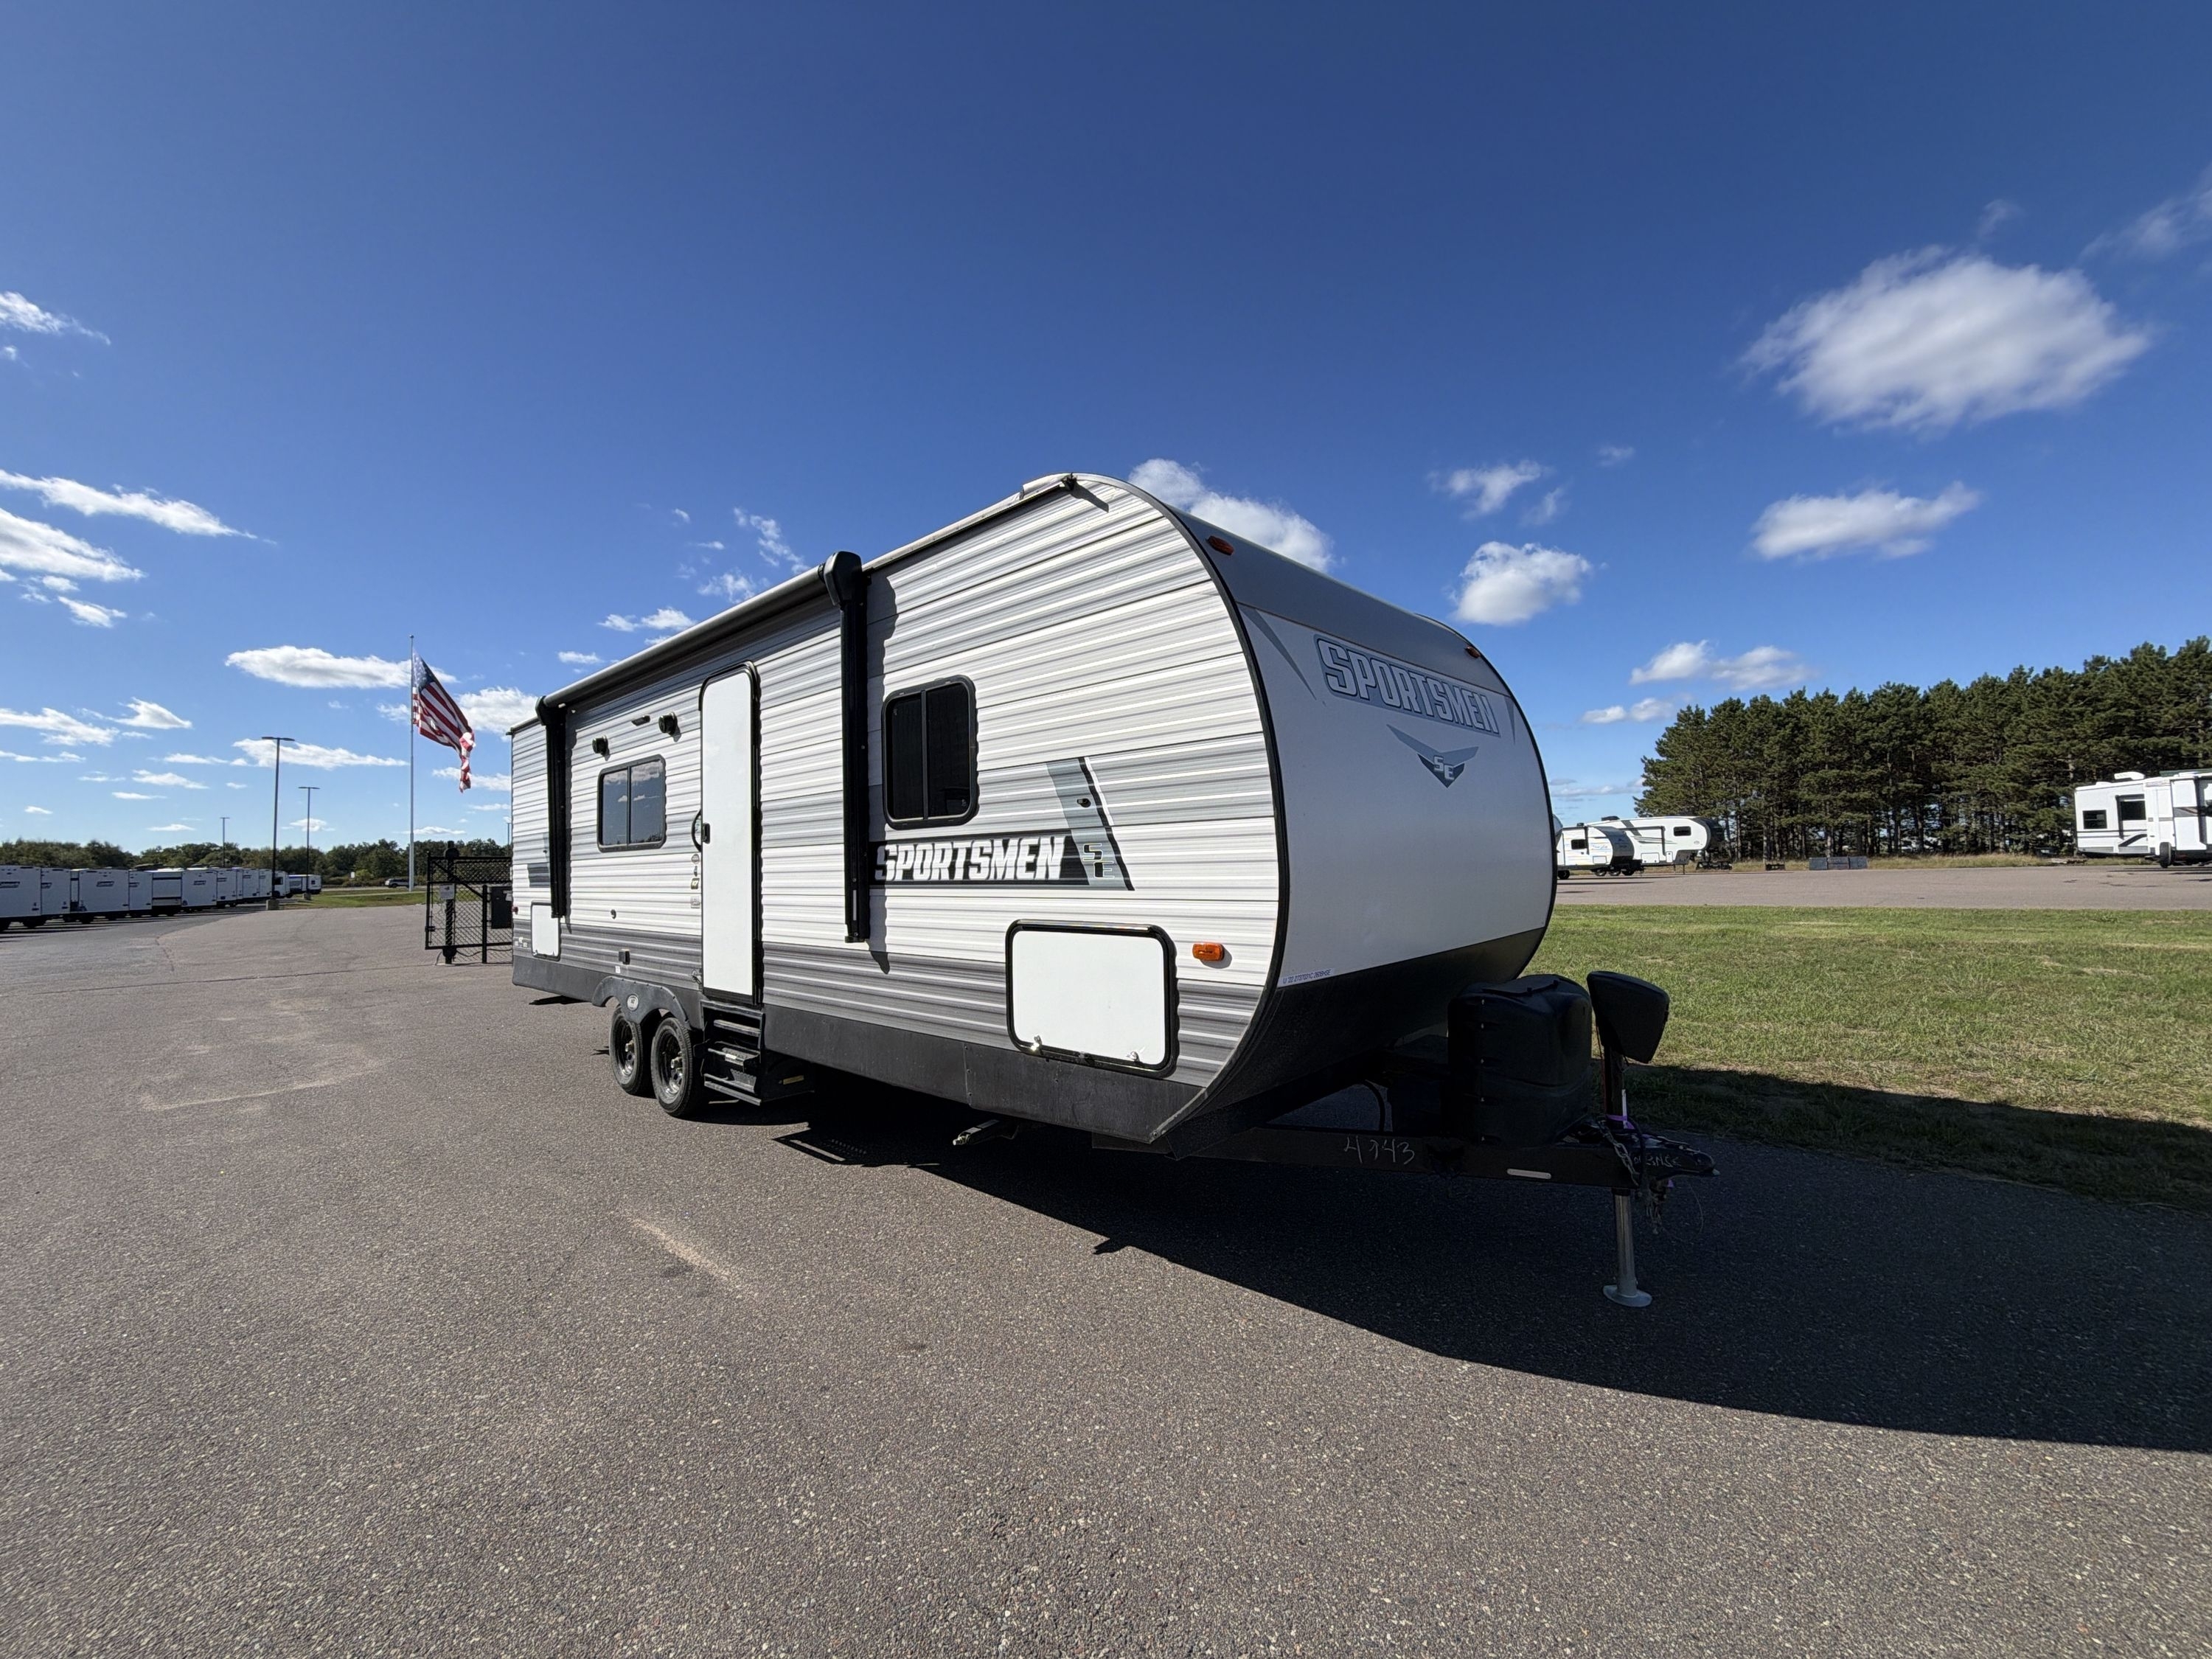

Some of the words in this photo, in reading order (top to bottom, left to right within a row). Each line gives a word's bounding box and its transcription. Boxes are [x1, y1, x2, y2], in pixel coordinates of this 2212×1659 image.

[1317, 638, 1500, 734] SPORTSMEN
[1433, 756, 1455, 781] SE
[875, 835, 1065, 880] SPORTSMEN
[1082, 843, 1115, 879] SE
